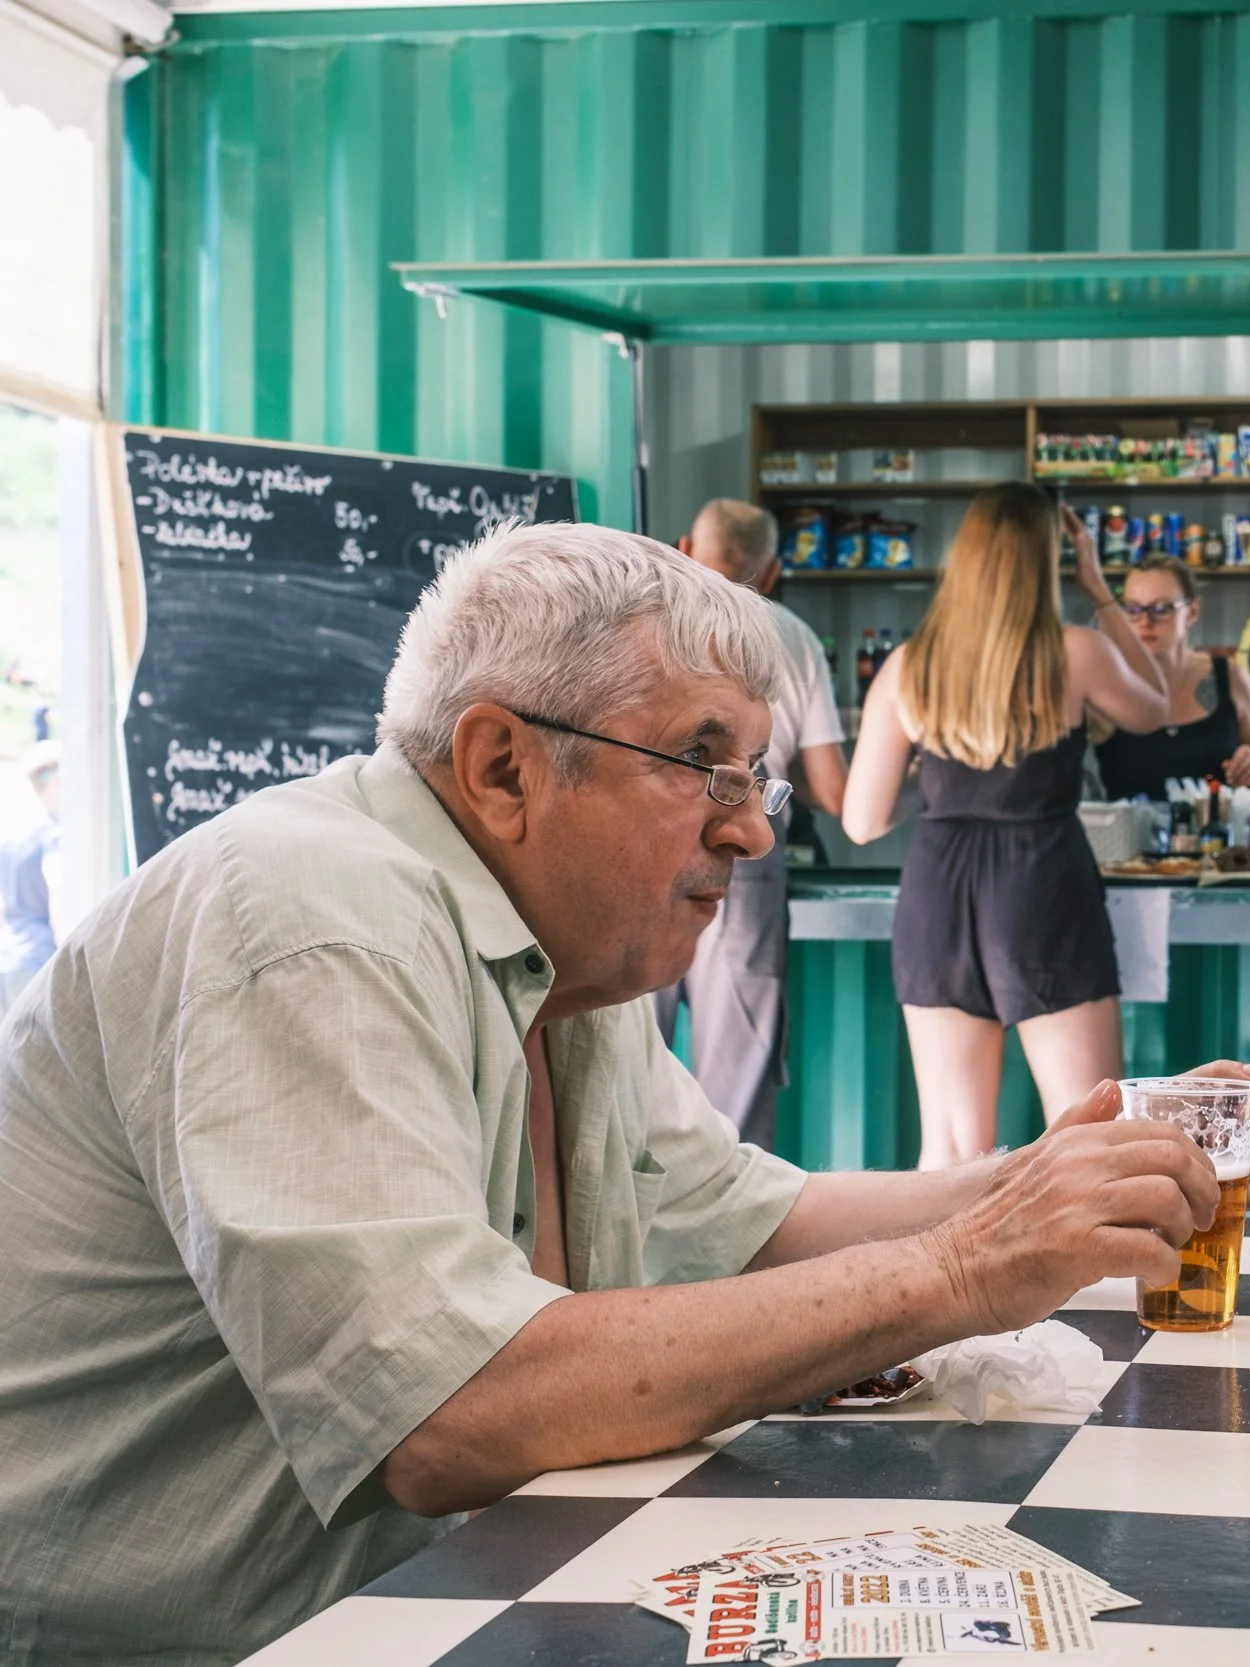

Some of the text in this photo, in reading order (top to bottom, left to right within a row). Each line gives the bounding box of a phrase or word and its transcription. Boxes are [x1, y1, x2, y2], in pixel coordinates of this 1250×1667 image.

[859, 1574, 890, 1604] 2022
[954, 1571, 969, 1598] ČERVENCE
[705, 1579, 760, 1658] BURZA
